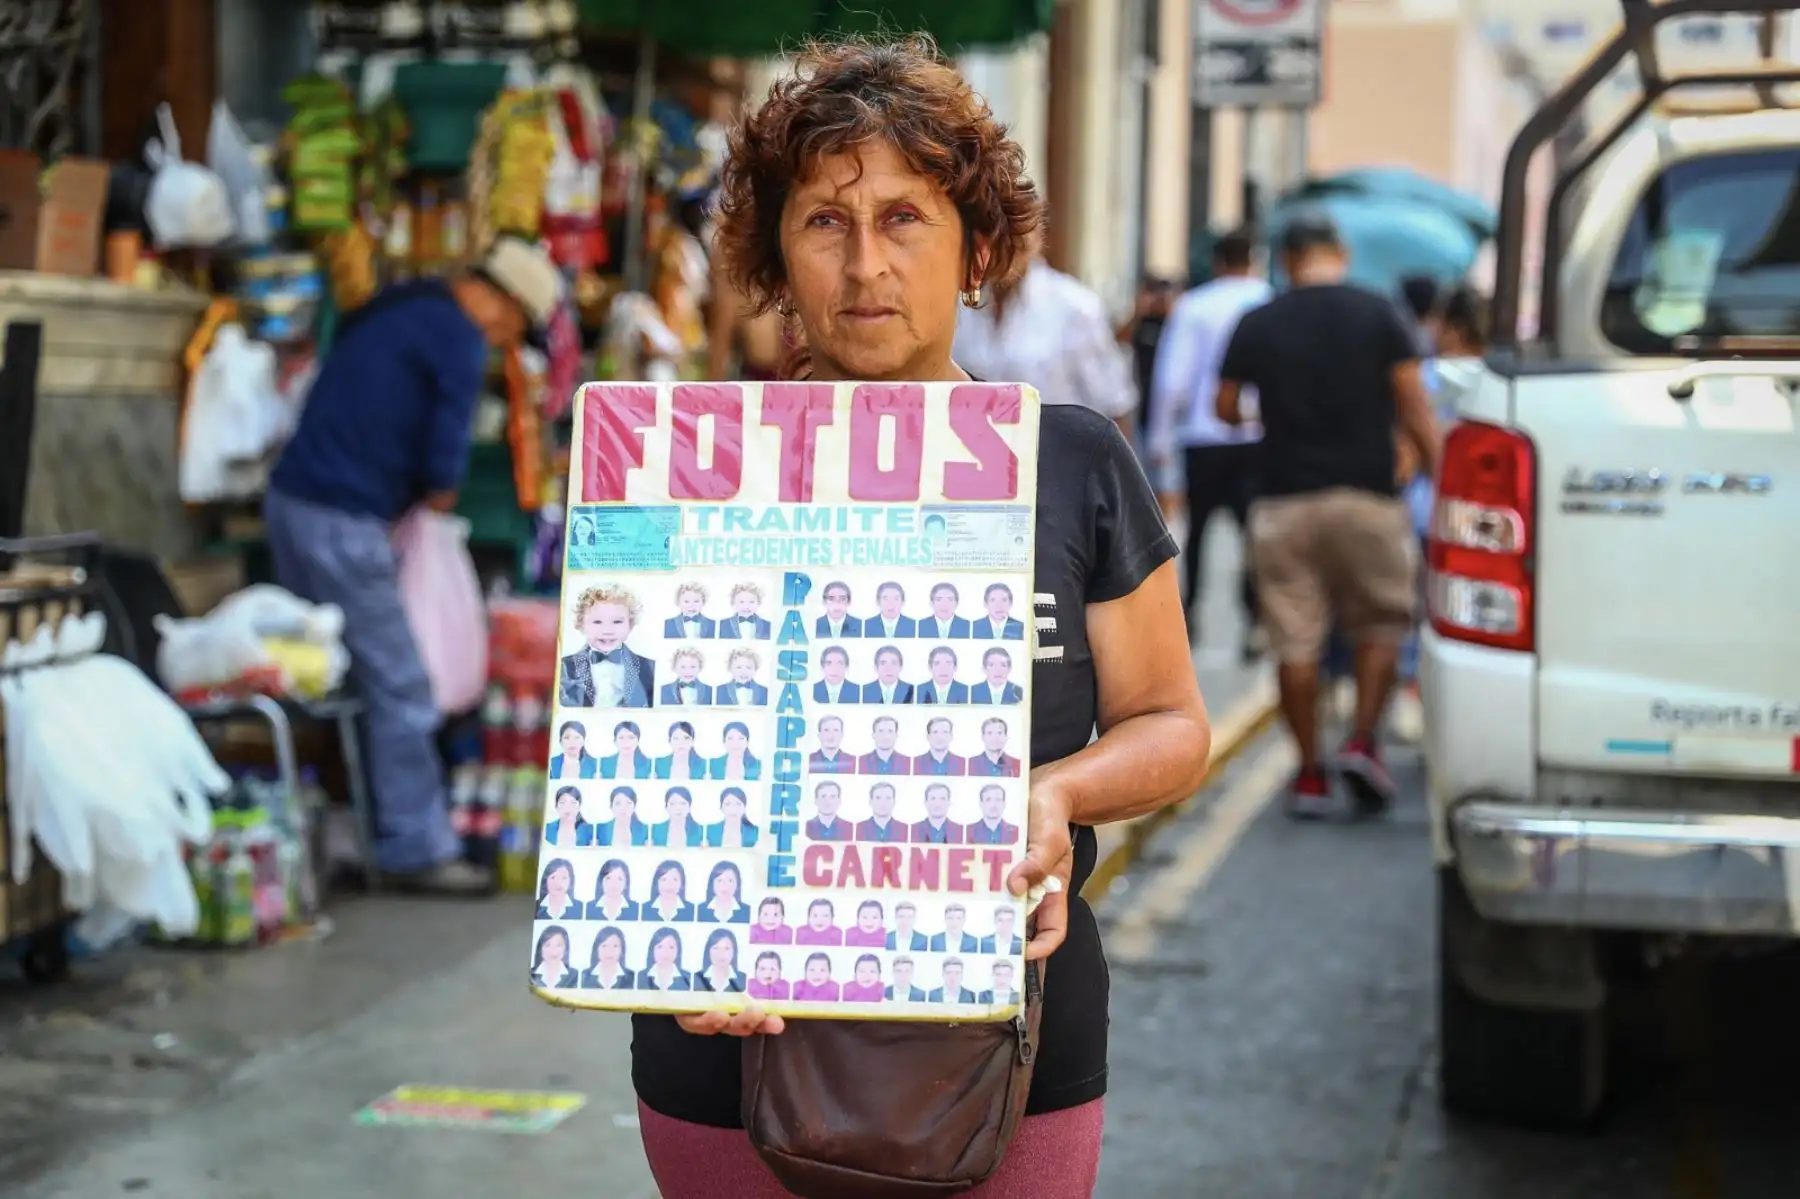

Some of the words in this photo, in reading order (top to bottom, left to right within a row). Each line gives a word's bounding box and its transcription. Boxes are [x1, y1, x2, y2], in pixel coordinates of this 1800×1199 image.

[582, 384, 1021, 503] FOTOS
[688, 506, 915, 534] TRAMITE
[670, 536, 833, 566] ANTECEDENTES
[839, 537, 933, 567] PENALES
[767, 572, 812, 888] PASAPORTE
[802, 844, 1013, 893] CARNET
